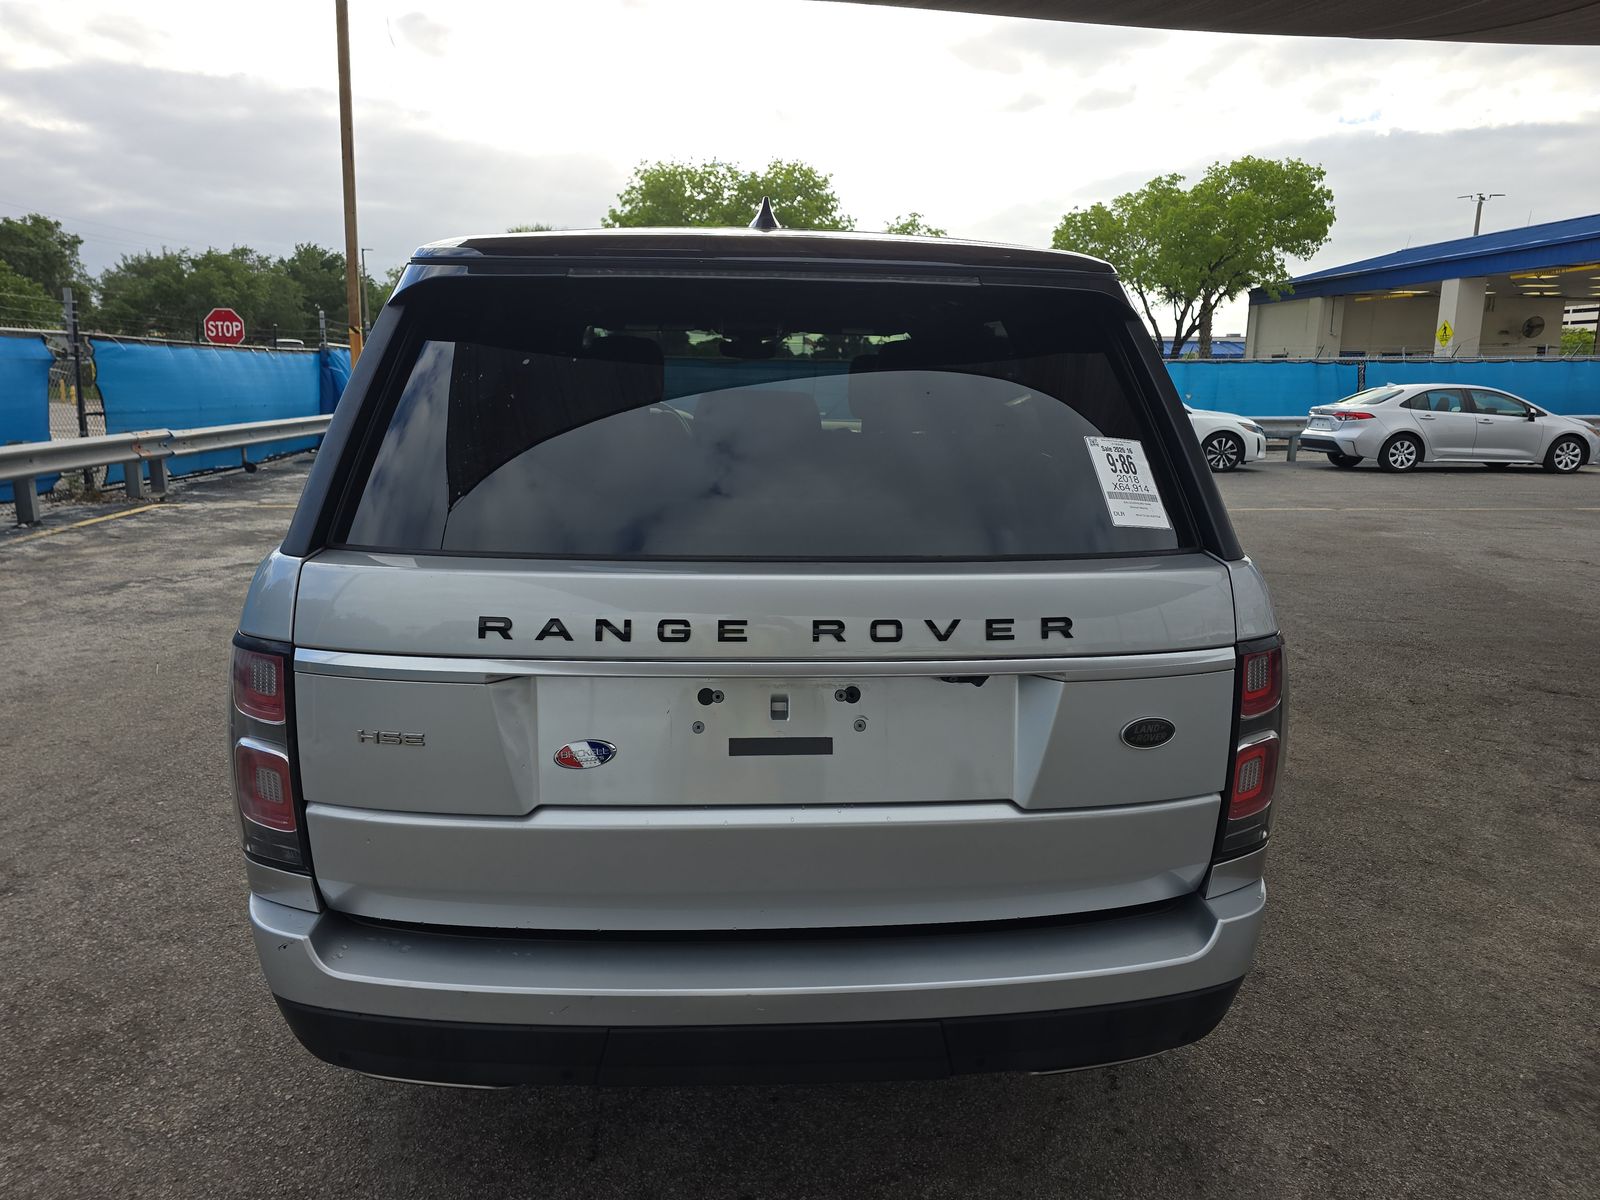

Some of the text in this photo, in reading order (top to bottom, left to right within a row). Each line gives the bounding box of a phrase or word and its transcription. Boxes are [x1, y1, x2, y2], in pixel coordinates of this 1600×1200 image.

[208, 321, 241, 337] STOP
[1106, 453, 1137, 475] 9:86
[1112, 482, 1149, 493] X64,914
[1117, 475, 1139, 484] 2018
[478, 616, 1074, 643] RANGE ROVER
[357, 729, 425, 746] HSE
